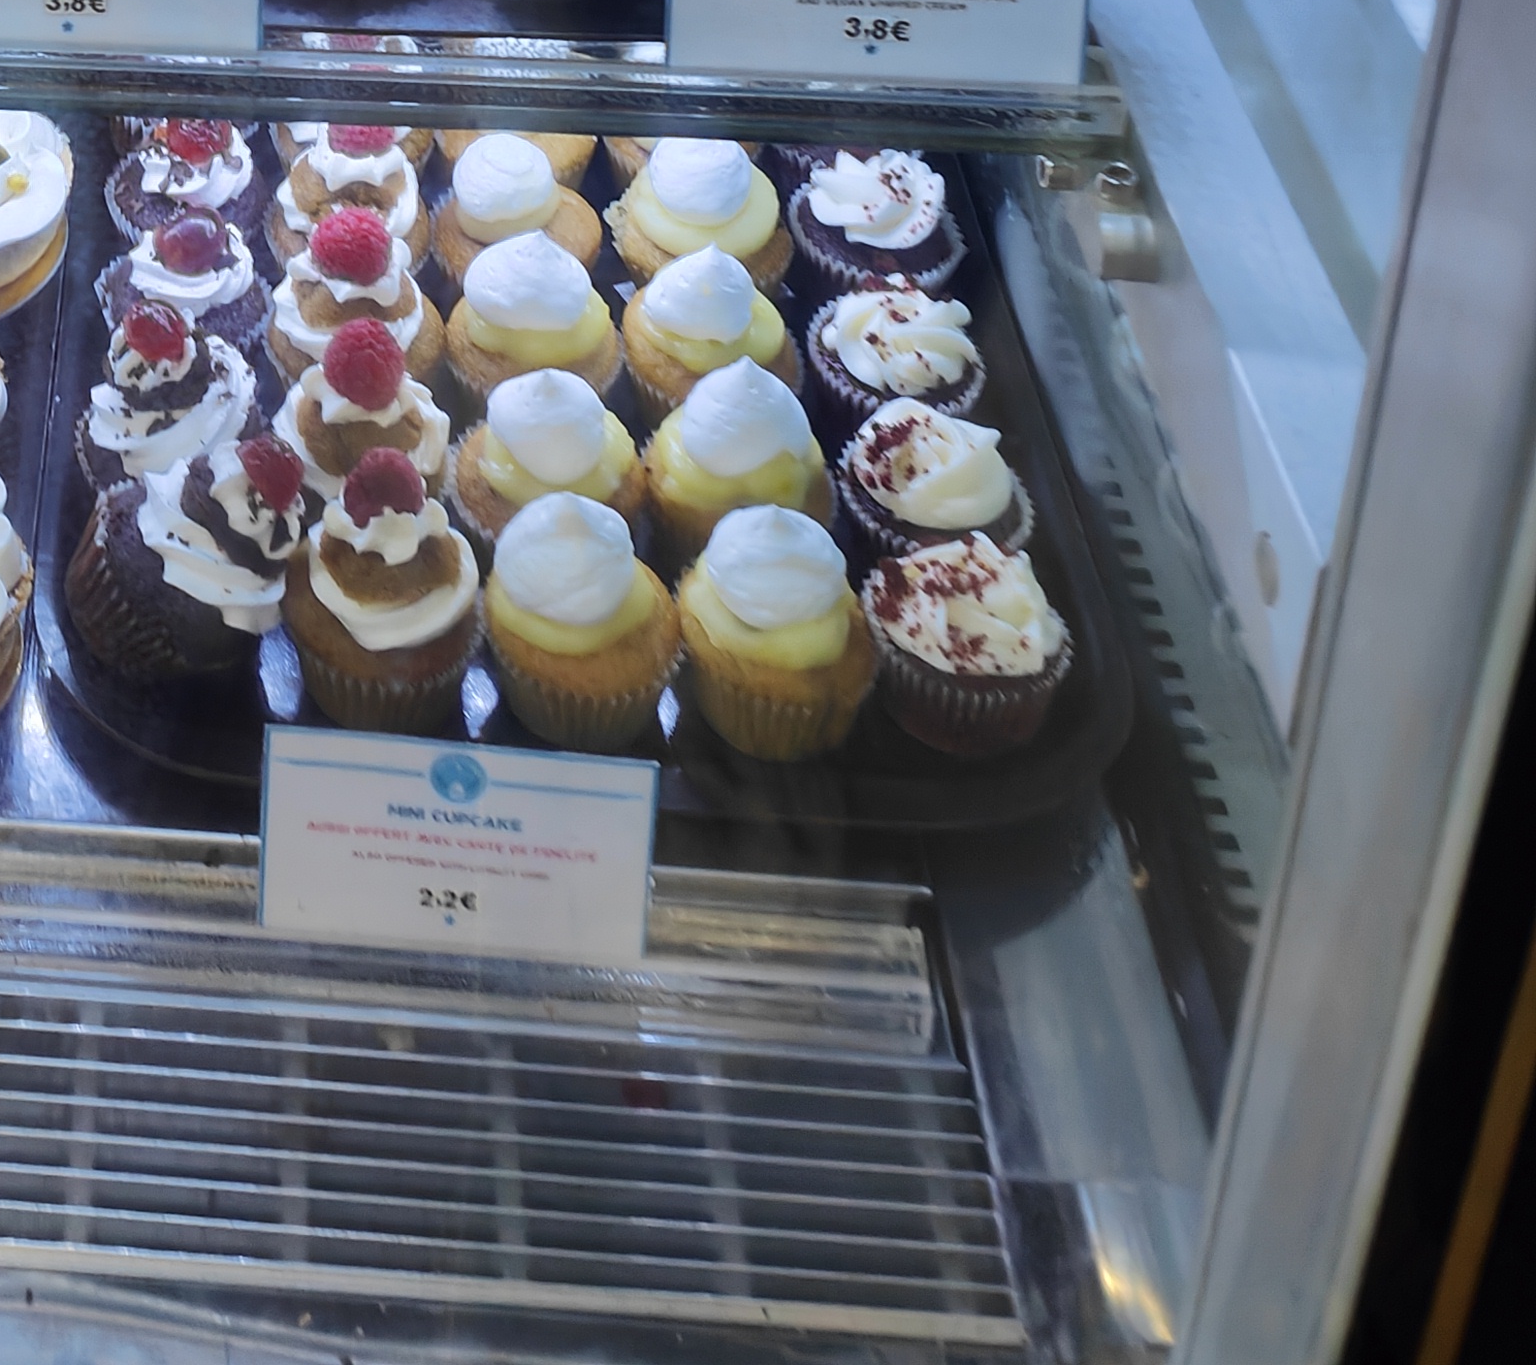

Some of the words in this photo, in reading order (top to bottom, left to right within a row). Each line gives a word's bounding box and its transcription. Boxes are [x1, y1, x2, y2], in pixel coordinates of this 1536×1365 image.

[844, 17, 910, 41] 3,8€
[387, 803, 425, 820] MINI
[432, 809, 522, 832] CUPCAKE
